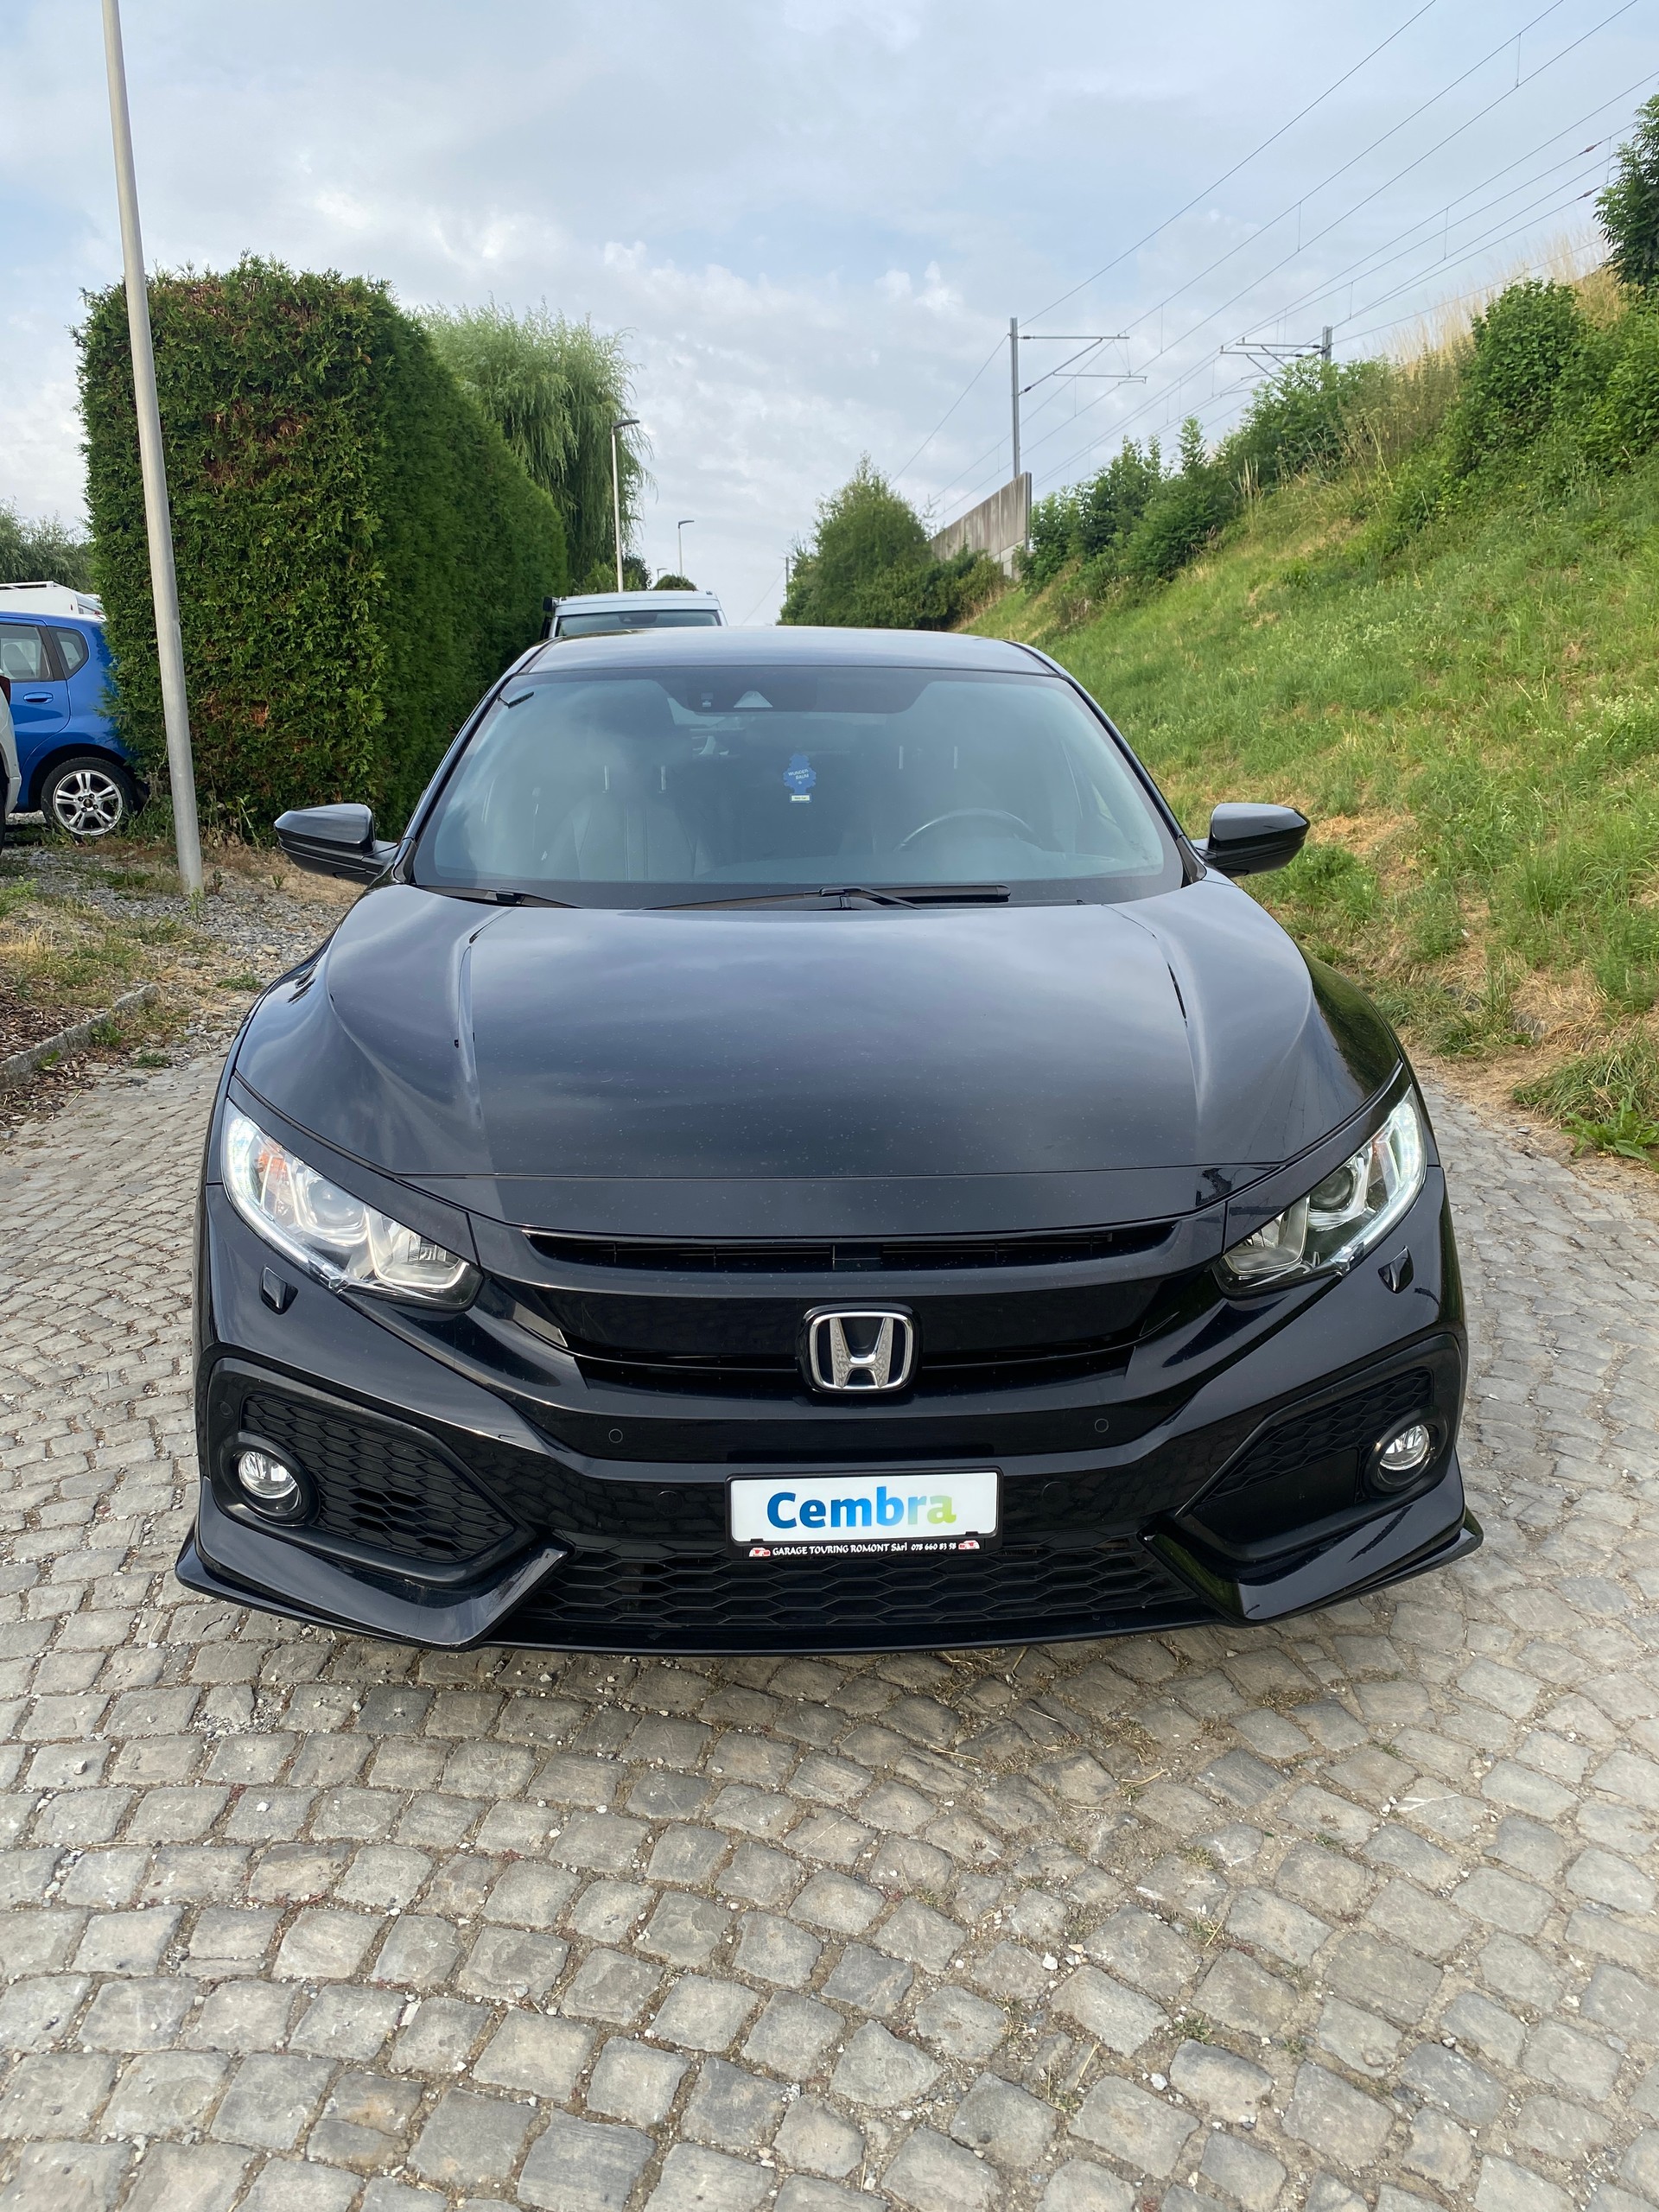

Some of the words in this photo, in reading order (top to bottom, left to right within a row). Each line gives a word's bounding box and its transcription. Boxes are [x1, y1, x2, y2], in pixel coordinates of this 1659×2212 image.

[767, 1486, 957, 1529] Cembra
[772, 1546, 808, 1556] GARAGE
[809, 1544, 849, 1555] TOURING
[850, 1543, 890, 1554] ROMONT
[891, 1541, 908, 1552] Sàrl
[925, 1542, 937, 1551] 660
